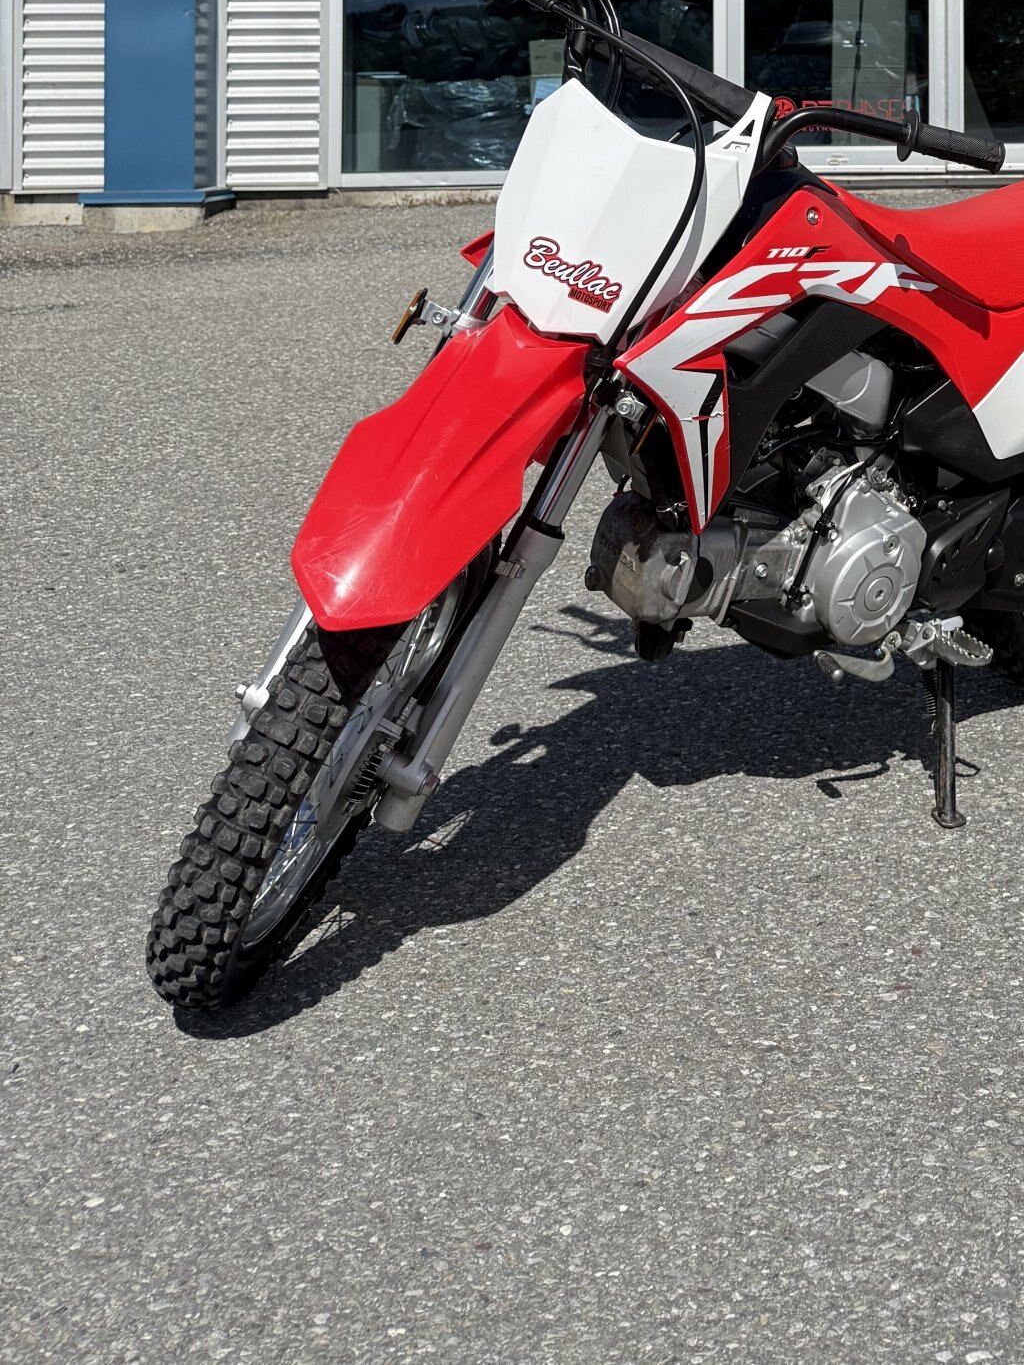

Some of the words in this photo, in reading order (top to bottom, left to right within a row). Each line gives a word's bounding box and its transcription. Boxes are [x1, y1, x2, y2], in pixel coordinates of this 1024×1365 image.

[524, 237, 621, 300] Beullac
[766, 245, 833, 260] 110F
[569, 287, 613, 312] MOTOSPORT
[684, 261, 940, 306] CRF
